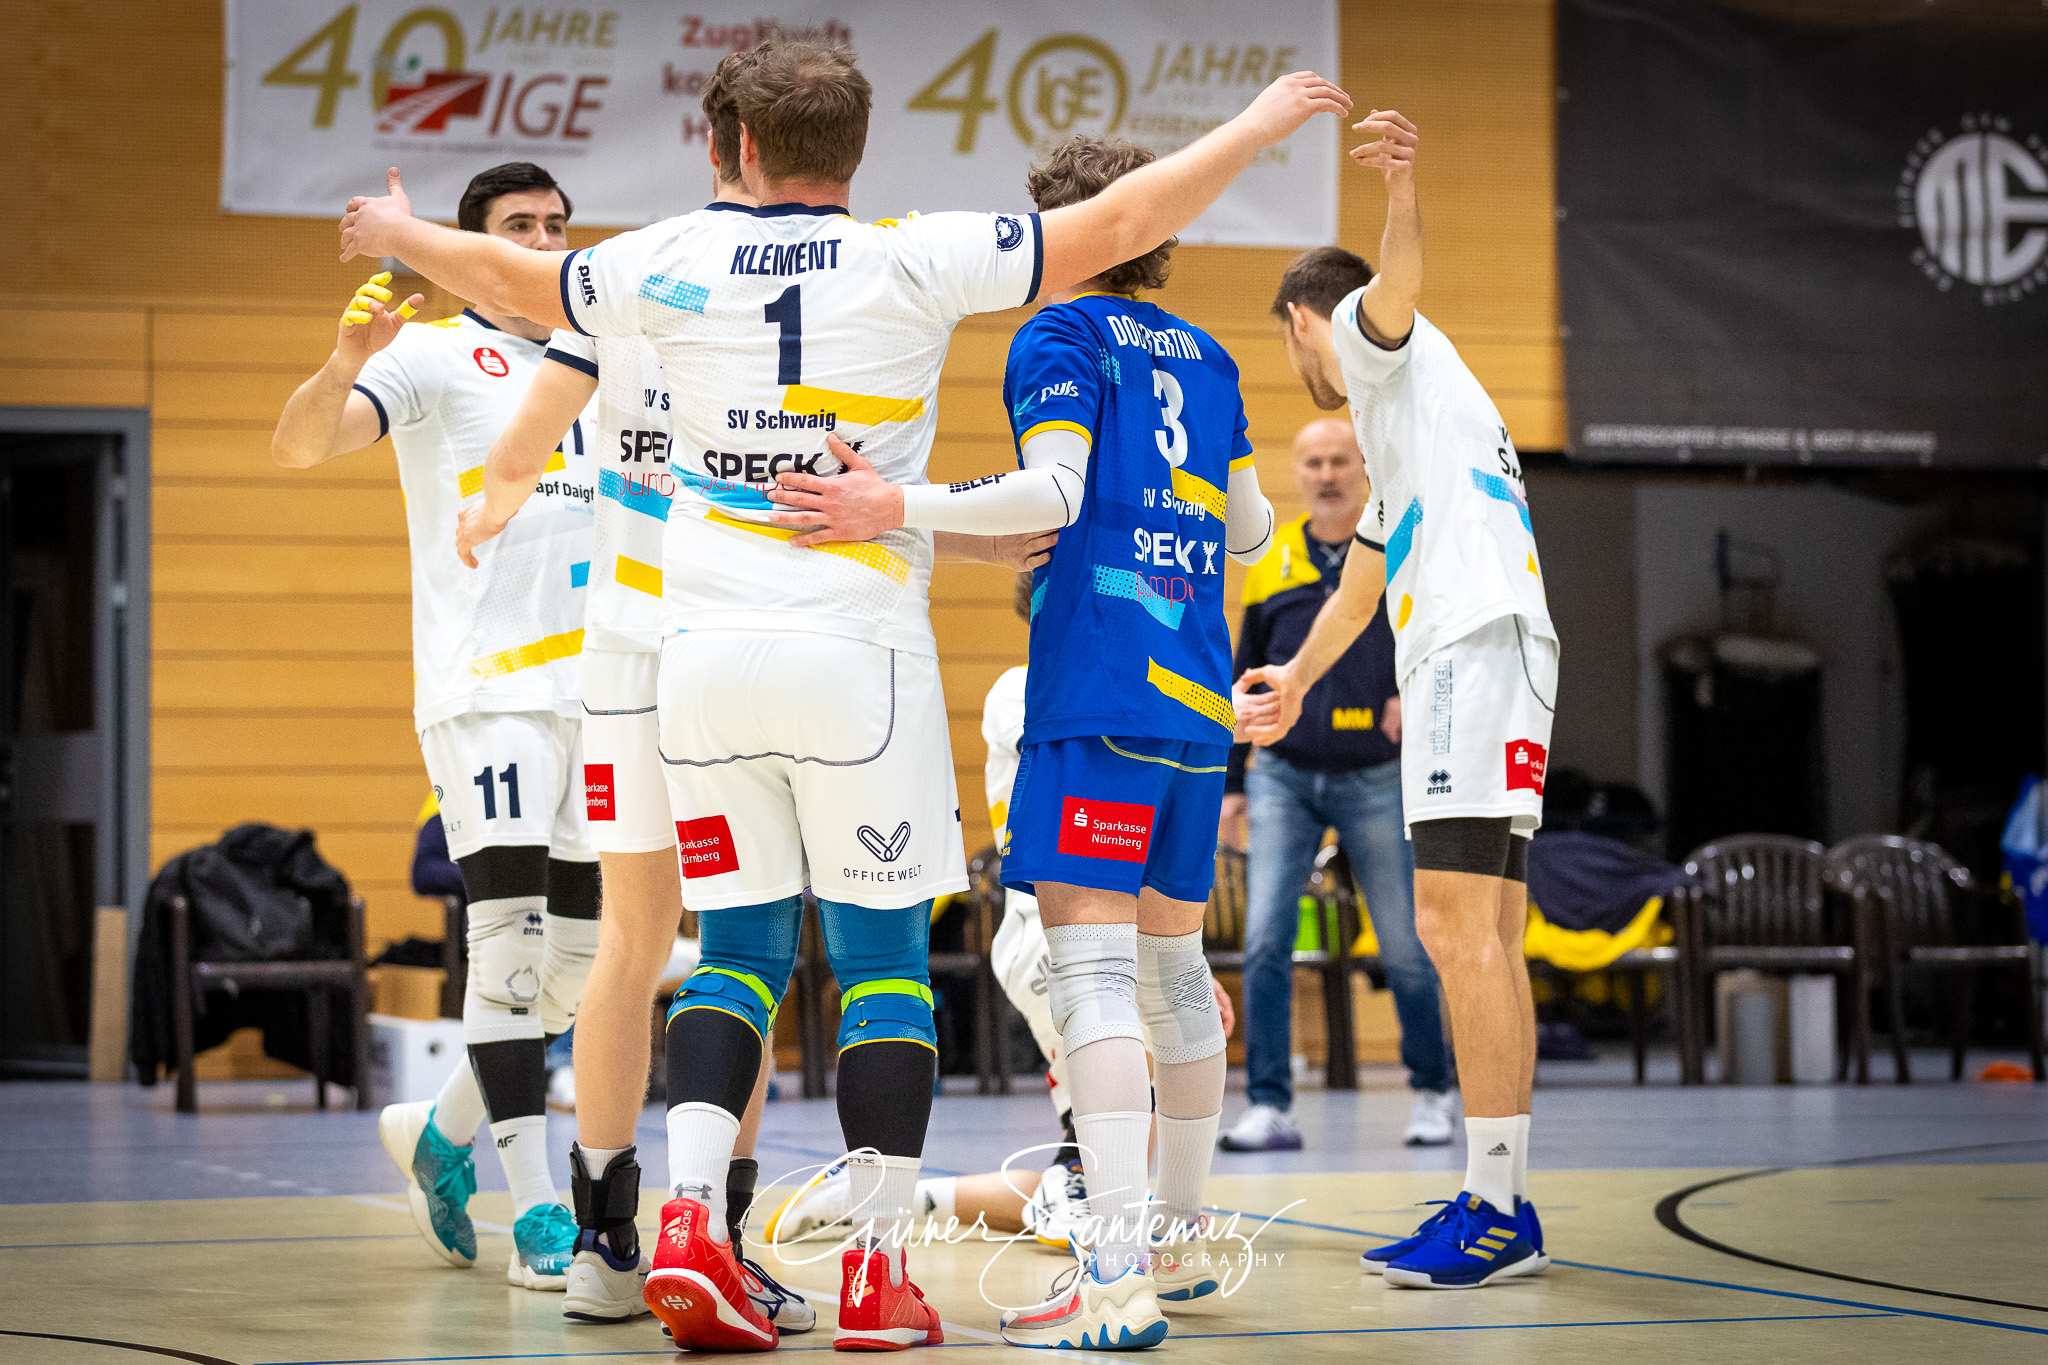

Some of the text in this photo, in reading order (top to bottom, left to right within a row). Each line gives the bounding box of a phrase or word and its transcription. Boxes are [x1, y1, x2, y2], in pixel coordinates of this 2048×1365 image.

[475, 7, 621, 53] JAHRE
[488, 71, 609, 140] IGE
[730, 238, 842, 277] KLEMENT
[577, 265, 598, 306] puls
[764, 283, 802, 386] 1
[1040, 380, 1079, 404] puls
[727, 408, 837, 432] SV Schwaig
[1152, 368, 1189, 469] 3
[534, 481, 559, 497] apf
[474, 762, 522, 820] 11
[1427, 785, 1452, 795] errea
[1091, 833, 1143, 850] Nürnberg
[1092, 819, 1147, 834] Sparkasse
[843, 864, 922, 882] OFFICEWELT
[677, 1209, 693, 1249] adidas
